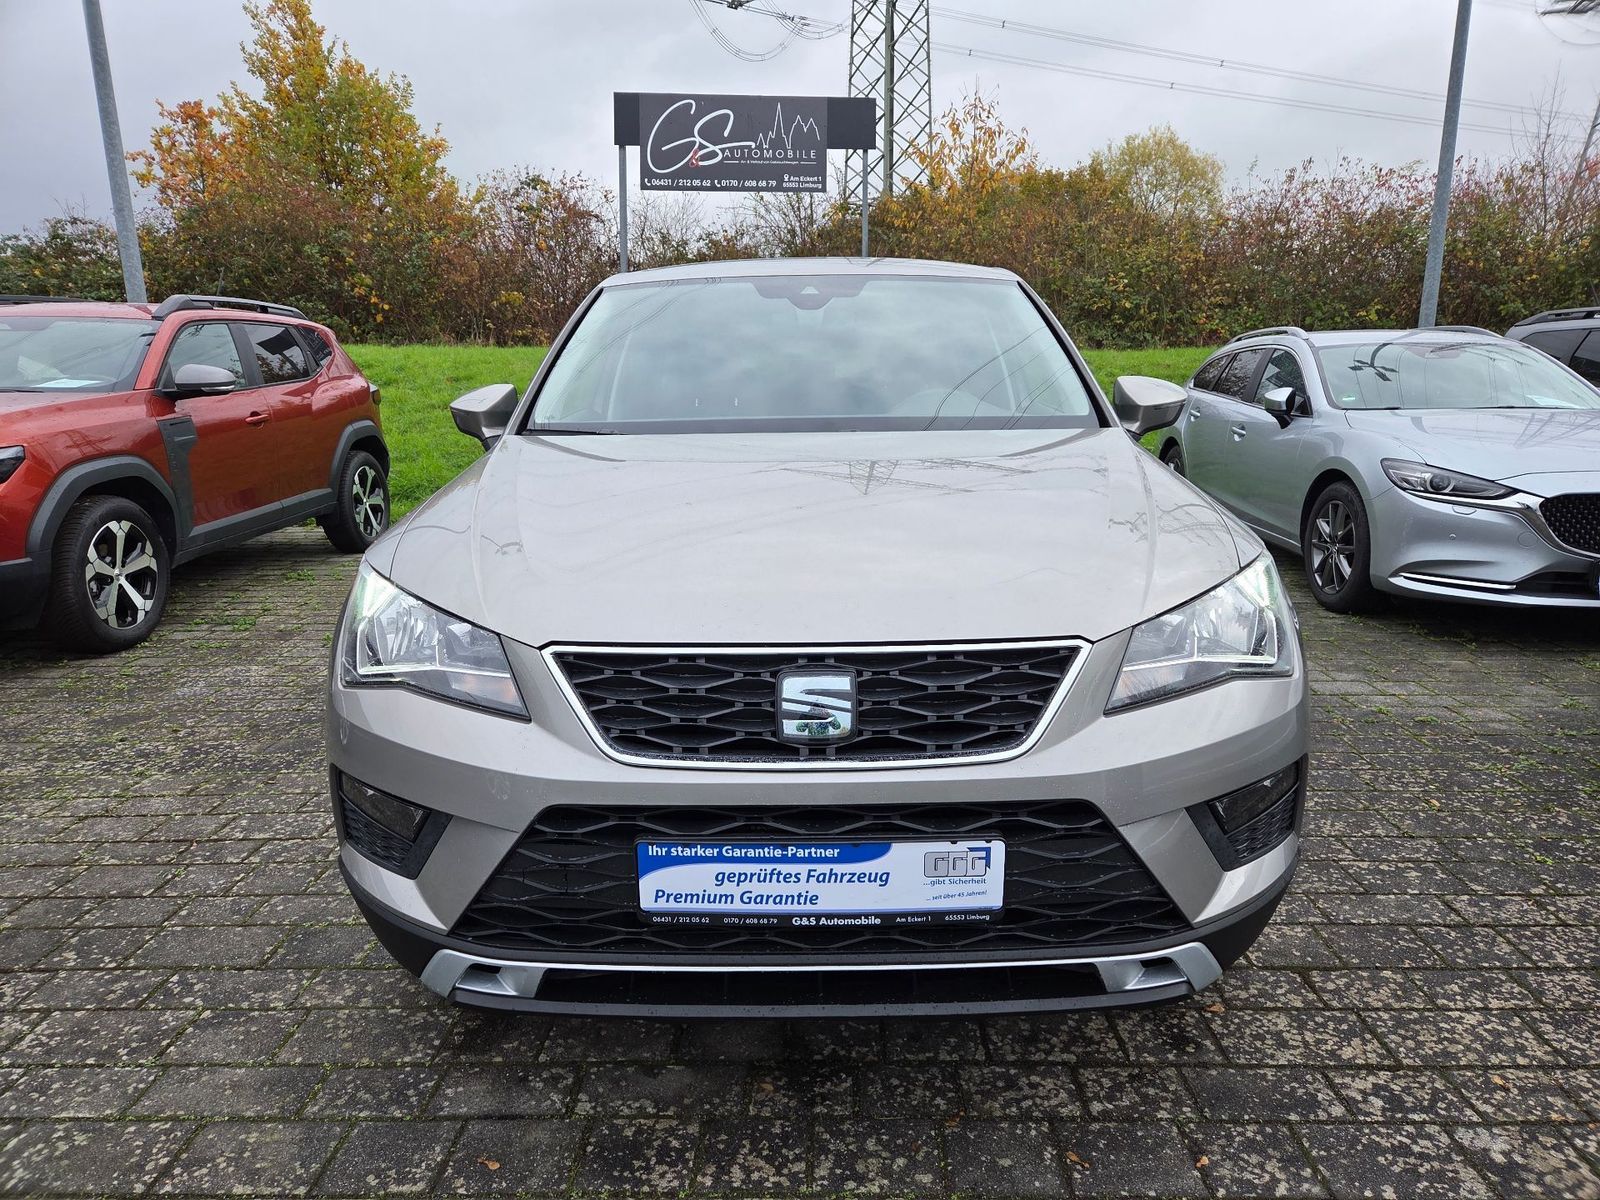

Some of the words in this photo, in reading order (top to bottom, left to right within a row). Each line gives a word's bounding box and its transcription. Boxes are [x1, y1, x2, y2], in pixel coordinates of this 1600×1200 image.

[724, 148, 816, 158] AUTOMOBILE
[648, 844, 668, 856] Ihr
[670, 844, 719, 857] starker
[722, 846, 840, 858] Garantie-Partner
[714, 868, 801, 887] geprüftes
[806, 868, 890, 887] Fahrzeug
[654, 889, 735, 904] Premium
[740, 890, 819, 905] Garantie
[792, 917, 816, 925] G&S
[819, 916, 881, 925] Automobile
